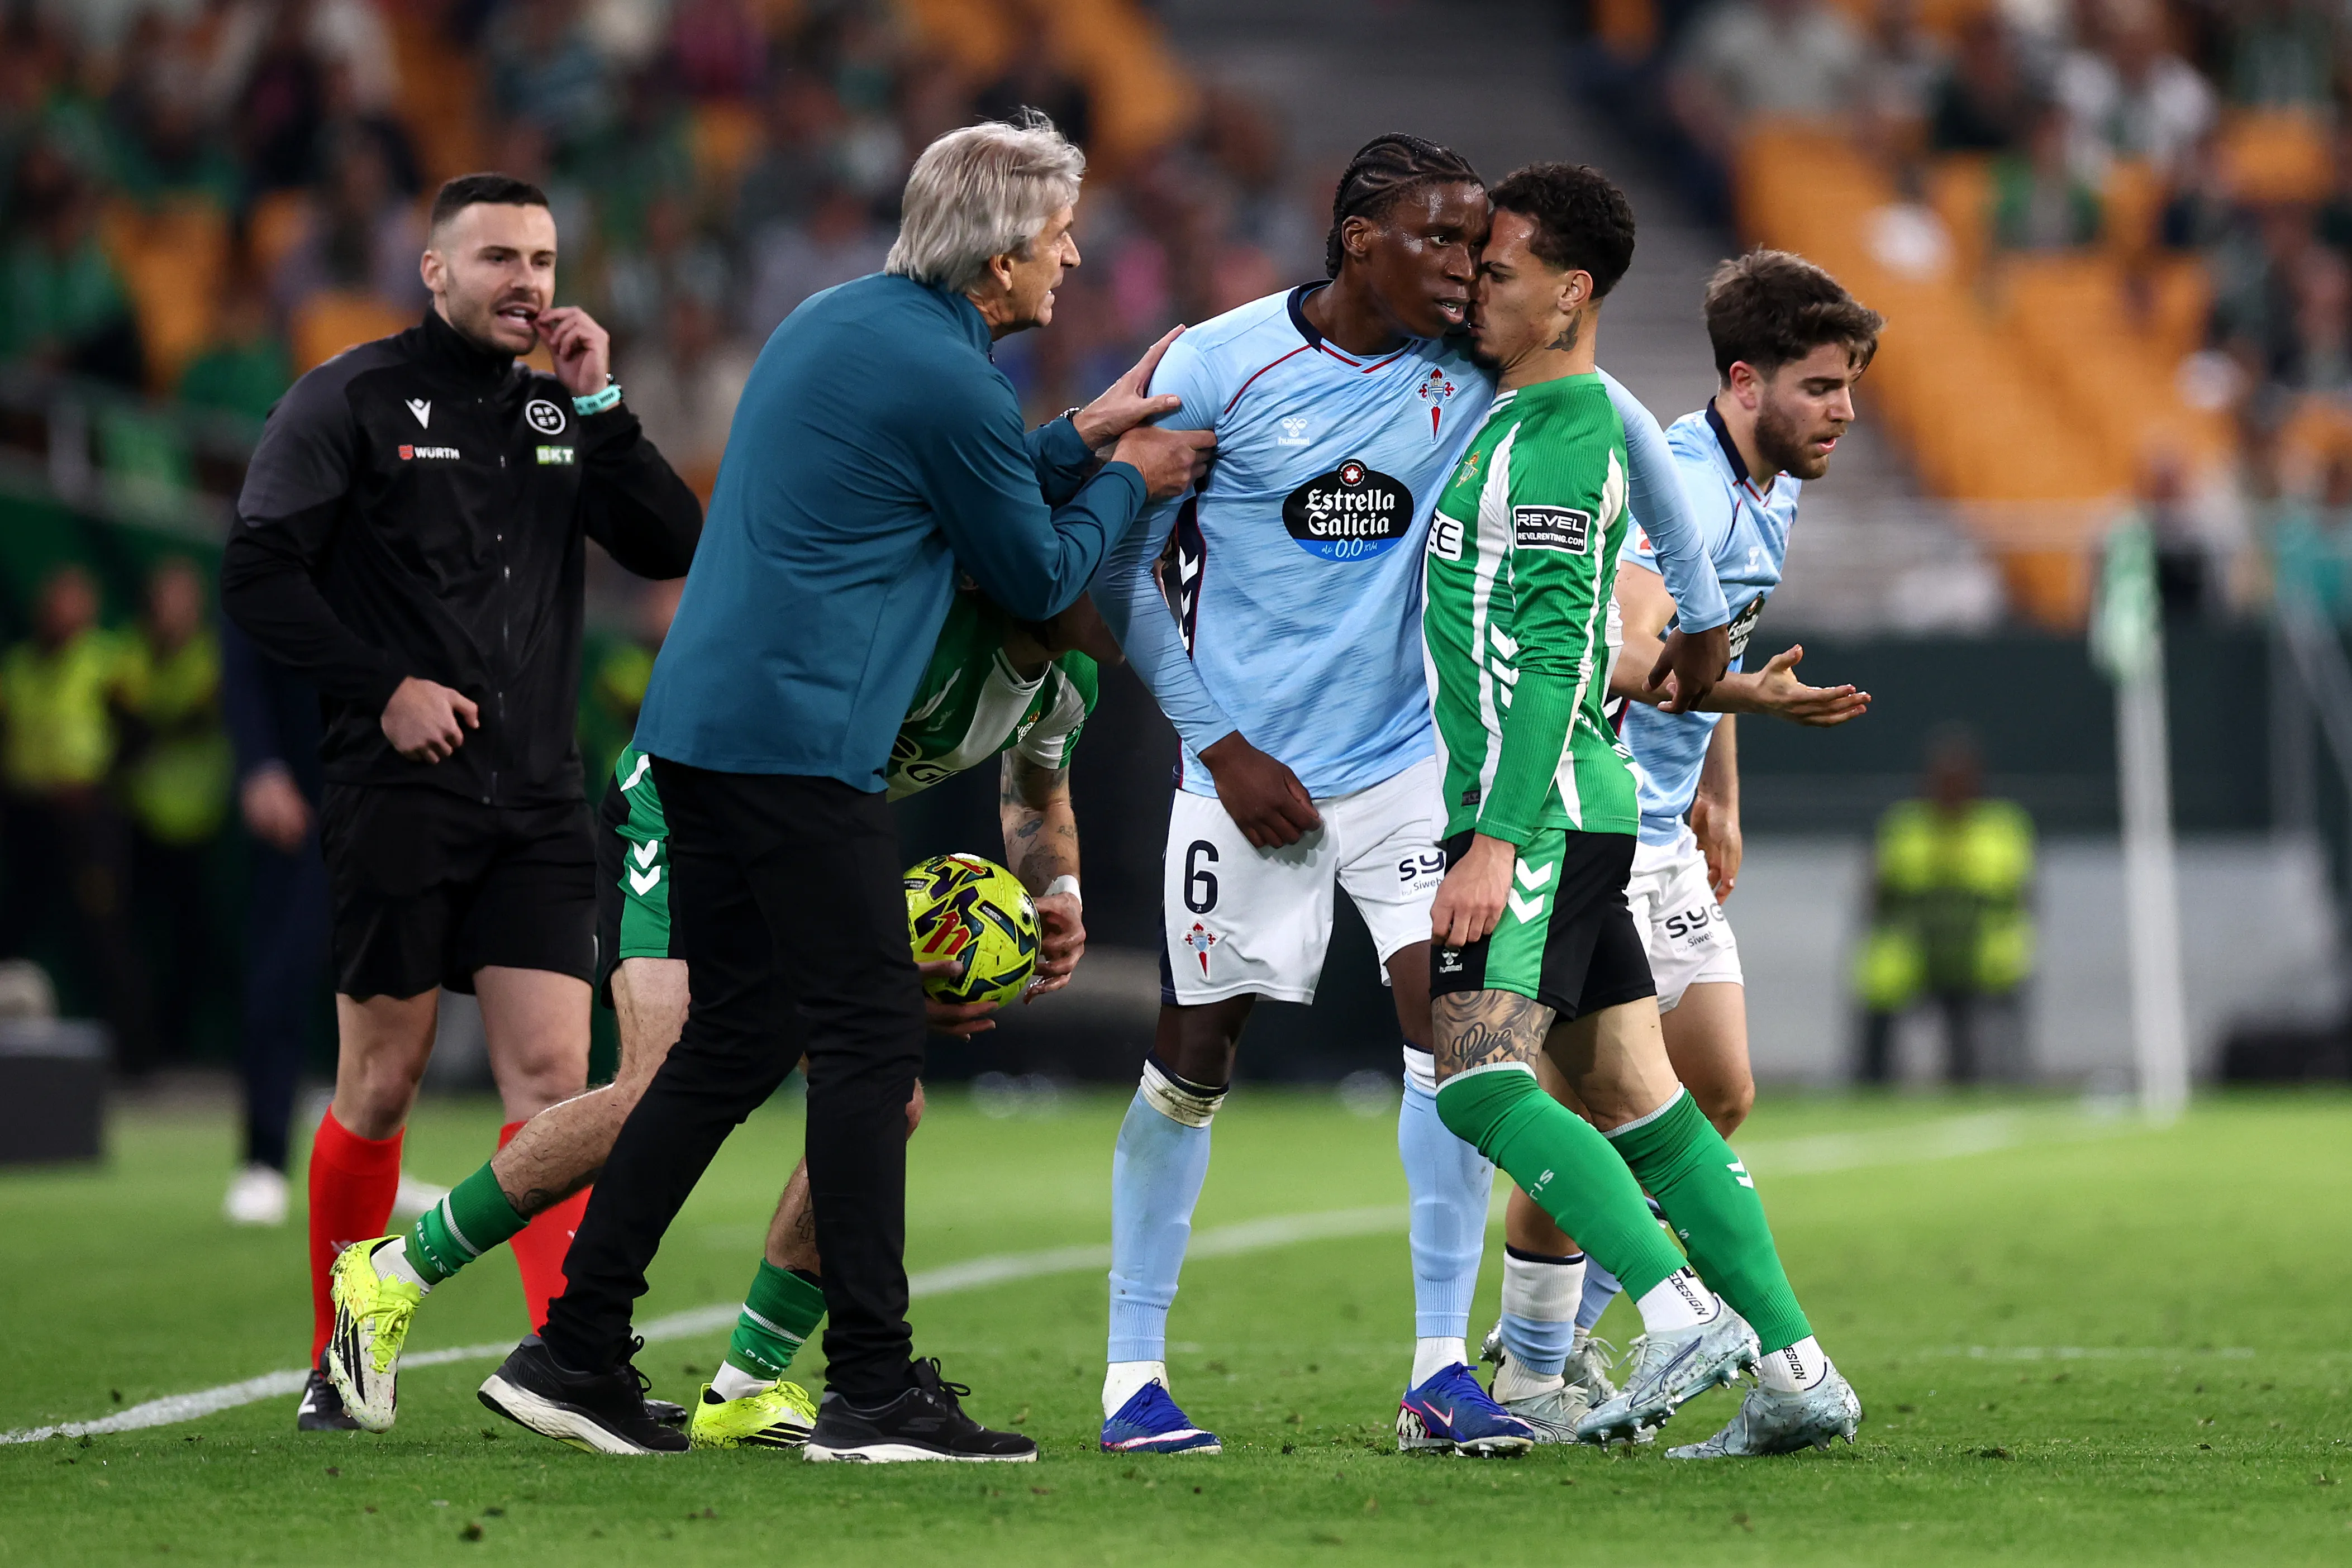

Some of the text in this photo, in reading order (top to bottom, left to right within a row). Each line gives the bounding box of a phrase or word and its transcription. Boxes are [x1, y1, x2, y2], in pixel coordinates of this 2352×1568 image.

[1278, 436, 1311, 445] hummel
[536, 447, 574, 462] BKT
[1304, 488, 1396, 512] Estrella
[1308, 511, 1389, 536] Galicia
[1517, 513, 1584, 533] REVEL
[1335, 537, 1364, 559] 0,0
[1517, 532, 1584, 547] REVELRENTING.COM
[1184, 840, 1219, 914] 6
[1439, 962, 1463, 974] hummel
